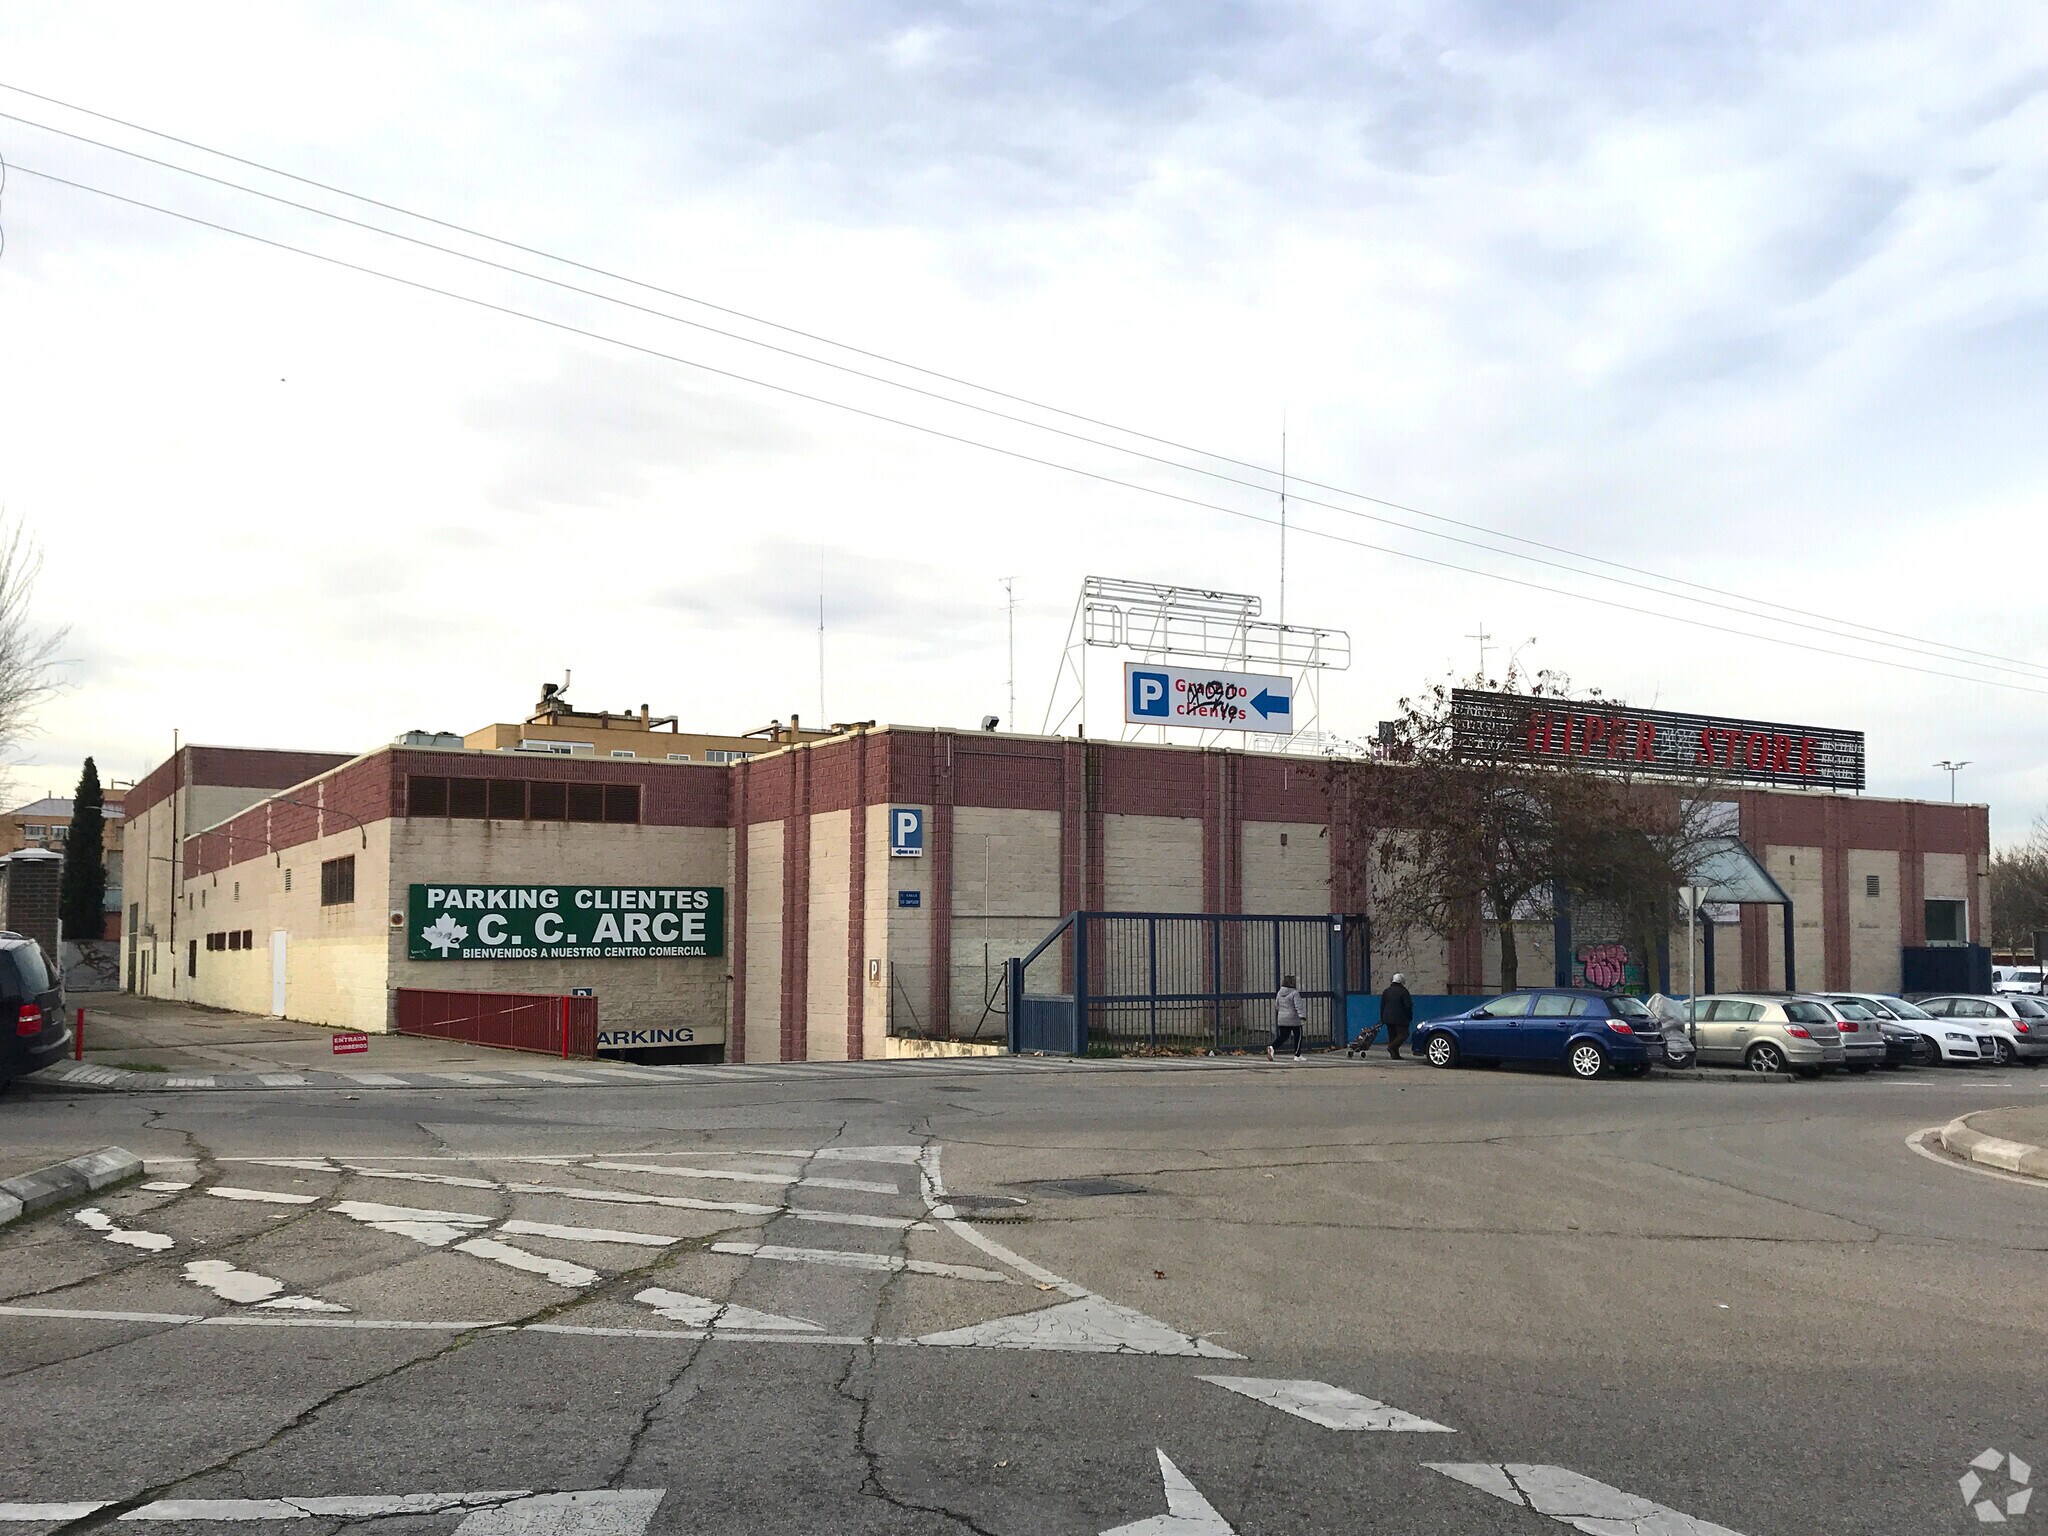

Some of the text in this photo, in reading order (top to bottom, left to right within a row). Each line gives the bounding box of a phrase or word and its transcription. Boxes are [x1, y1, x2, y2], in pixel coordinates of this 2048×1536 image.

[1140, 678, 1163, 710] P
[1526, 712, 1656, 762] HIPER
[1696, 727, 1818, 775] STORE
[897, 812, 918, 846] P
[427, 888, 709, 910] PARKING CLIENTES
[477, 913, 522, 945] C.
[534, 912, 577, 944] C.
[591, 912, 706, 943] ARCE
[462, 946, 707, 959] BIENVENIDOS A NUESTRO CENTRO COMERCIAL
[871, 960, 878, 980] P
[334, 1043, 368, 1051] BOMBEROS
[597, 1028, 694, 1047] ARKING
